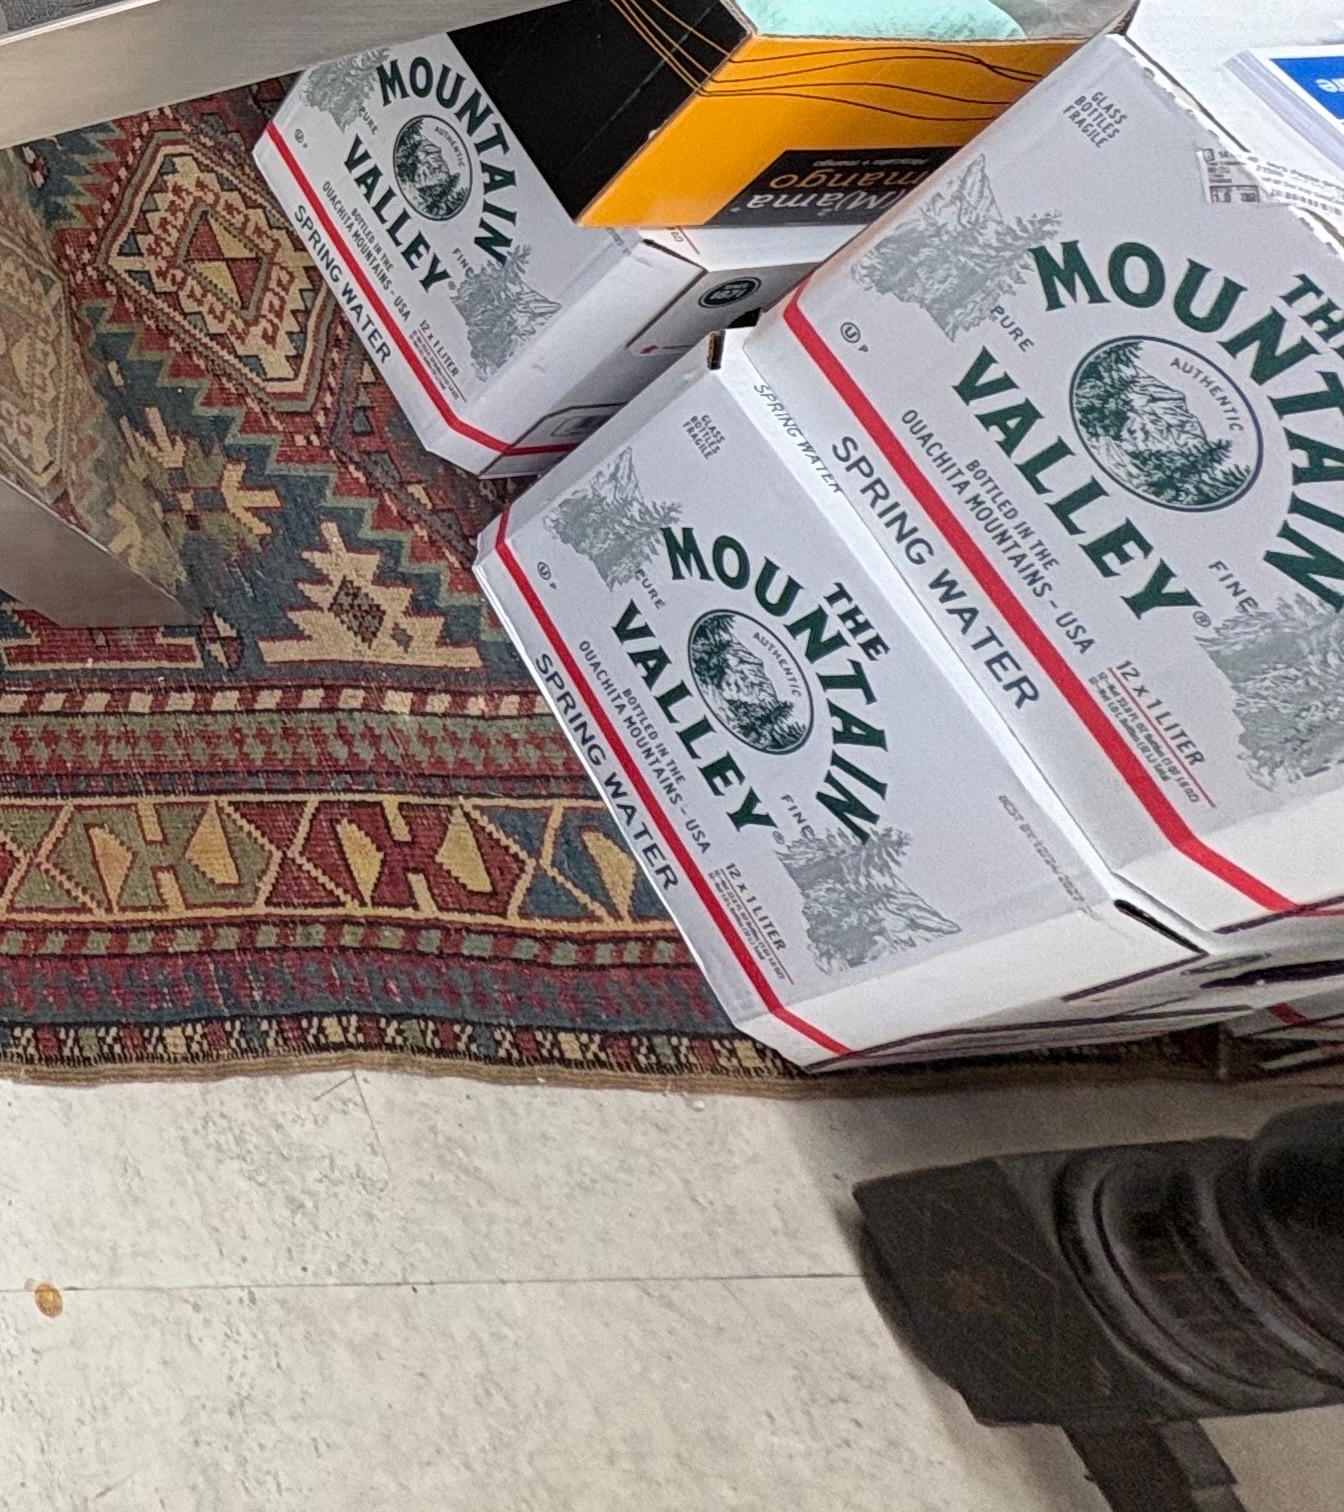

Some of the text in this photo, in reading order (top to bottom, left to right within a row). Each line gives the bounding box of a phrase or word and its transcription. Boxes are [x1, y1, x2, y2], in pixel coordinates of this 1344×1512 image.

[359, 105, 379, 136] PURE
[434, 125, 466, 169] AUTHENTIC
[1062, 104, 1109, 149] FRAGILE
[1073, 95, 1121, 140] BOTTLES
[1091, 91, 1128, 126] GLASS
[375, 56, 518, 268] MOUNTAIN
[769, 169, 929, 188] mango
[322, 180, 354, 233] OUACHITA
[351, 229, 393, 291] MOUNTAINS
[393, 295, 412, 322] USA
[344, 134, 451, 293] VALLEY
[351, 207, 395, 273] BOTTLED IN THE
[294, 204, 392, 365] SPRING WATER
[419, 319, 430, 333] 12
[426, 332, 434, 341] x
[436, 346, 461, 378] LITER
[989, 305, 1035, 353] PURE
[699, 413, 726, 443] GLASS
[754, 383, 803, 439] SPRING
[1027, 240, 1344, 614] MOUNTAIN
[1169, 356, 1245, 434] AUTHENTIC
[682, 421, 714, 461] FRAGILE
[690, 415, 720, 455] BOTTLES
[951, 345, 1204, 621] VALLEY
[964, 458, 1060, 572] BOTTLED IN THE
[900, 409, 966, 496] OUACHITA
[963, 493, 1054, 600] MOUNTAINS
[1054, 610, 1097, 655] USA
[635, 569, 668, 610] PURE
[832, 435, 1041, 710] SPRING WATER
[1208, 560, 1260, 613] FINE
[824, 582, 891, 661] THE
[659, 526, 890, 846] MOUNTAIN
[753, 631, 803, 700] AUTHENTIC
[578, 640, 628, 717] OUACHITA
[622, 714, 683, 806] MOUNTAINS
[684, 817, 712, 855] USA
[612, 599, 779, 833] VALLEY
[621, 687, 688, 786] BOTTLED IN THE
[1115, 659, 1206, 768] 12 x 1 LITER
[536, 653, 679, 891] SPRING WATER
[780, 793, 817, 837] FINE
[721, 862, 788, 952] 12 x 1 LITER
